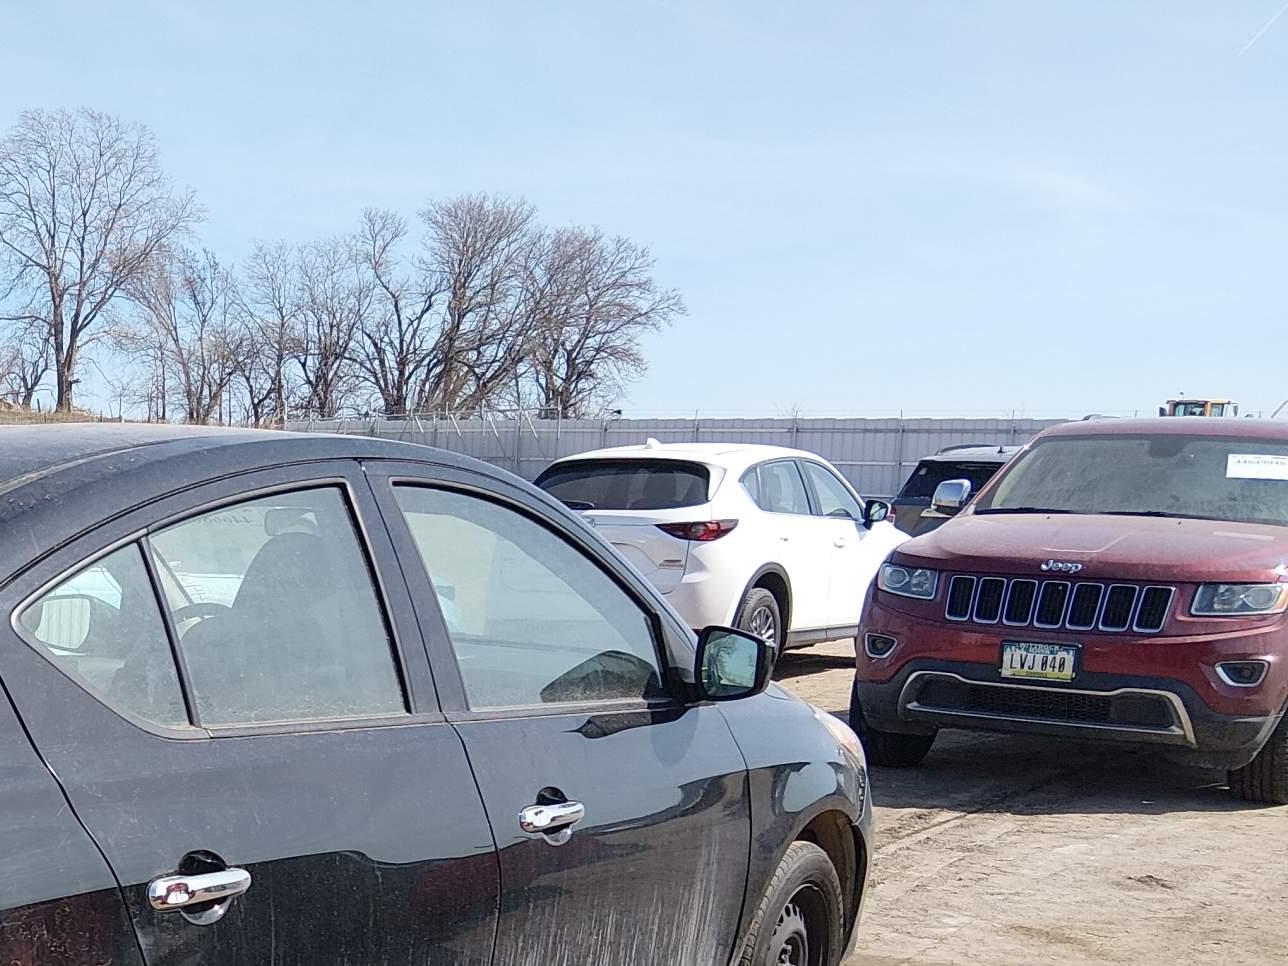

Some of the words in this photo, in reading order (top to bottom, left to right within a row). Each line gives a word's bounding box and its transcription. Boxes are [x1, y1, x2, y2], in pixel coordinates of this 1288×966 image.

[1040, 559, 1082, 574] Jeep
[1009, 653, 1036, 671] LVJ
[1040, 655, 1066, 673] 040
